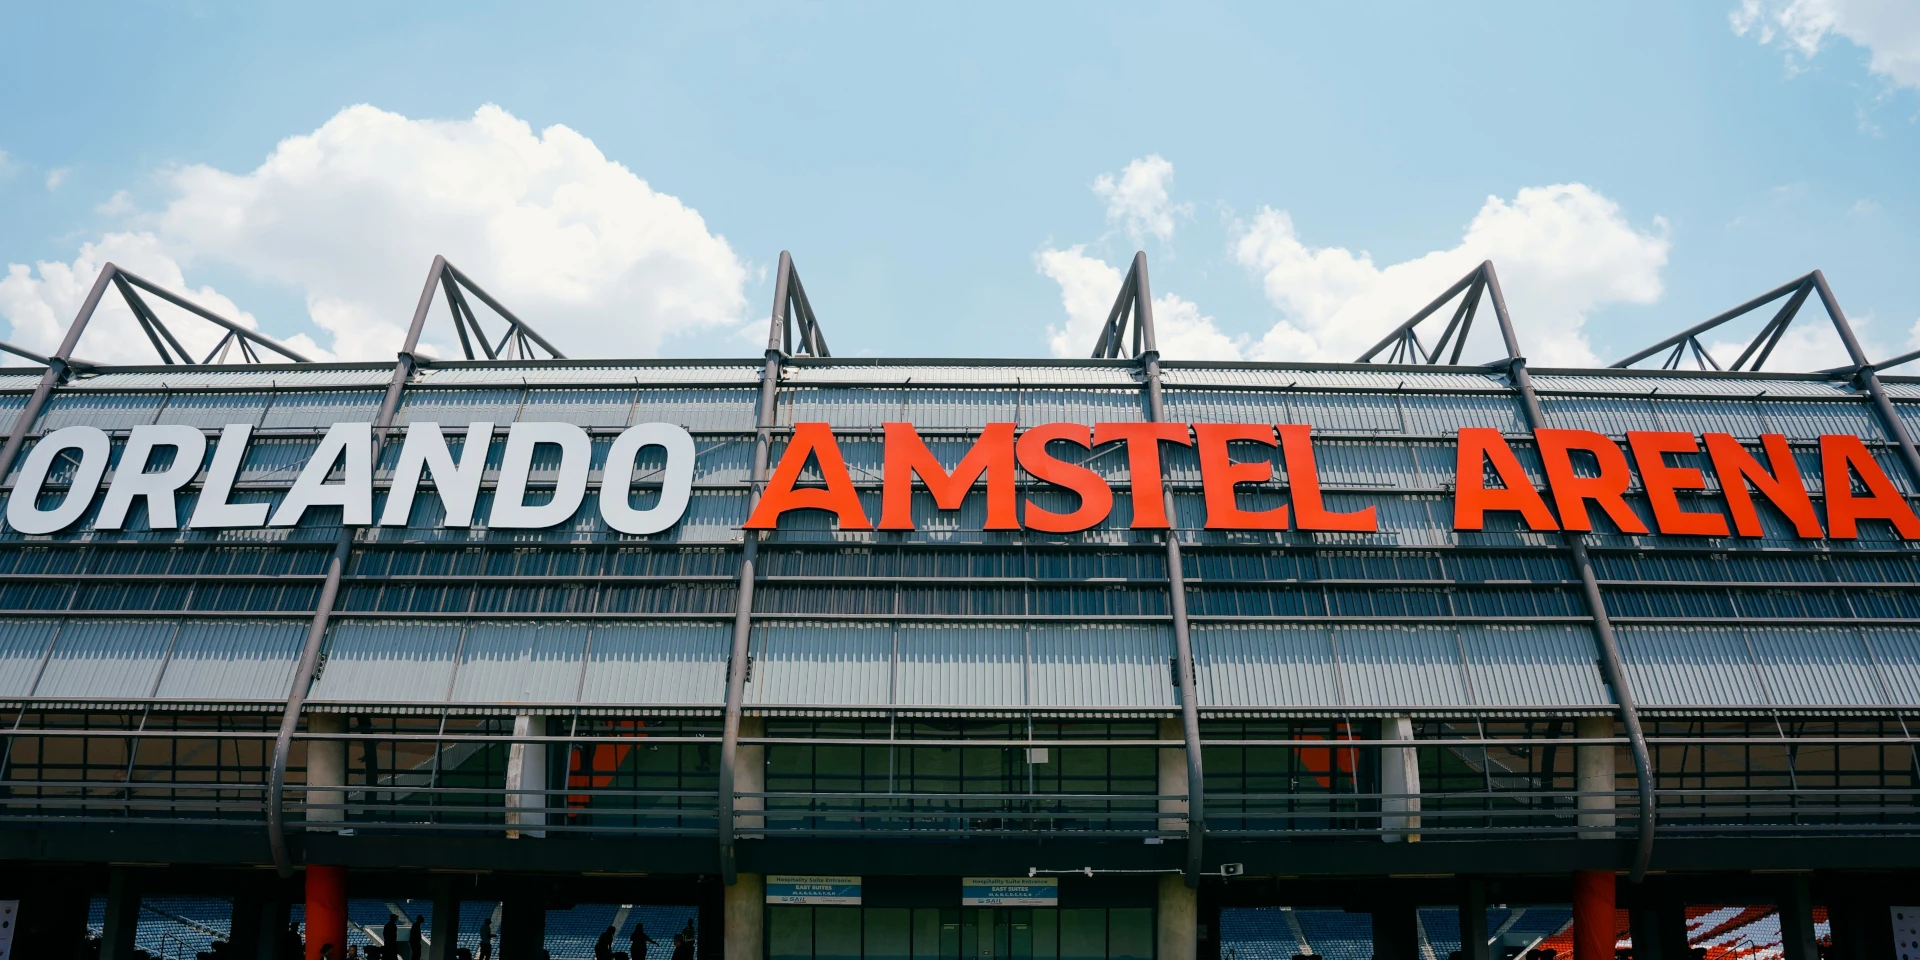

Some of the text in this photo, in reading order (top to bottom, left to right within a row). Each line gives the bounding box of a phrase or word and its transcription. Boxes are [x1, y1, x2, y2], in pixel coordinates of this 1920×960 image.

[5, 421, 1920, 540] ORLANDO AMSTEL ARENA
